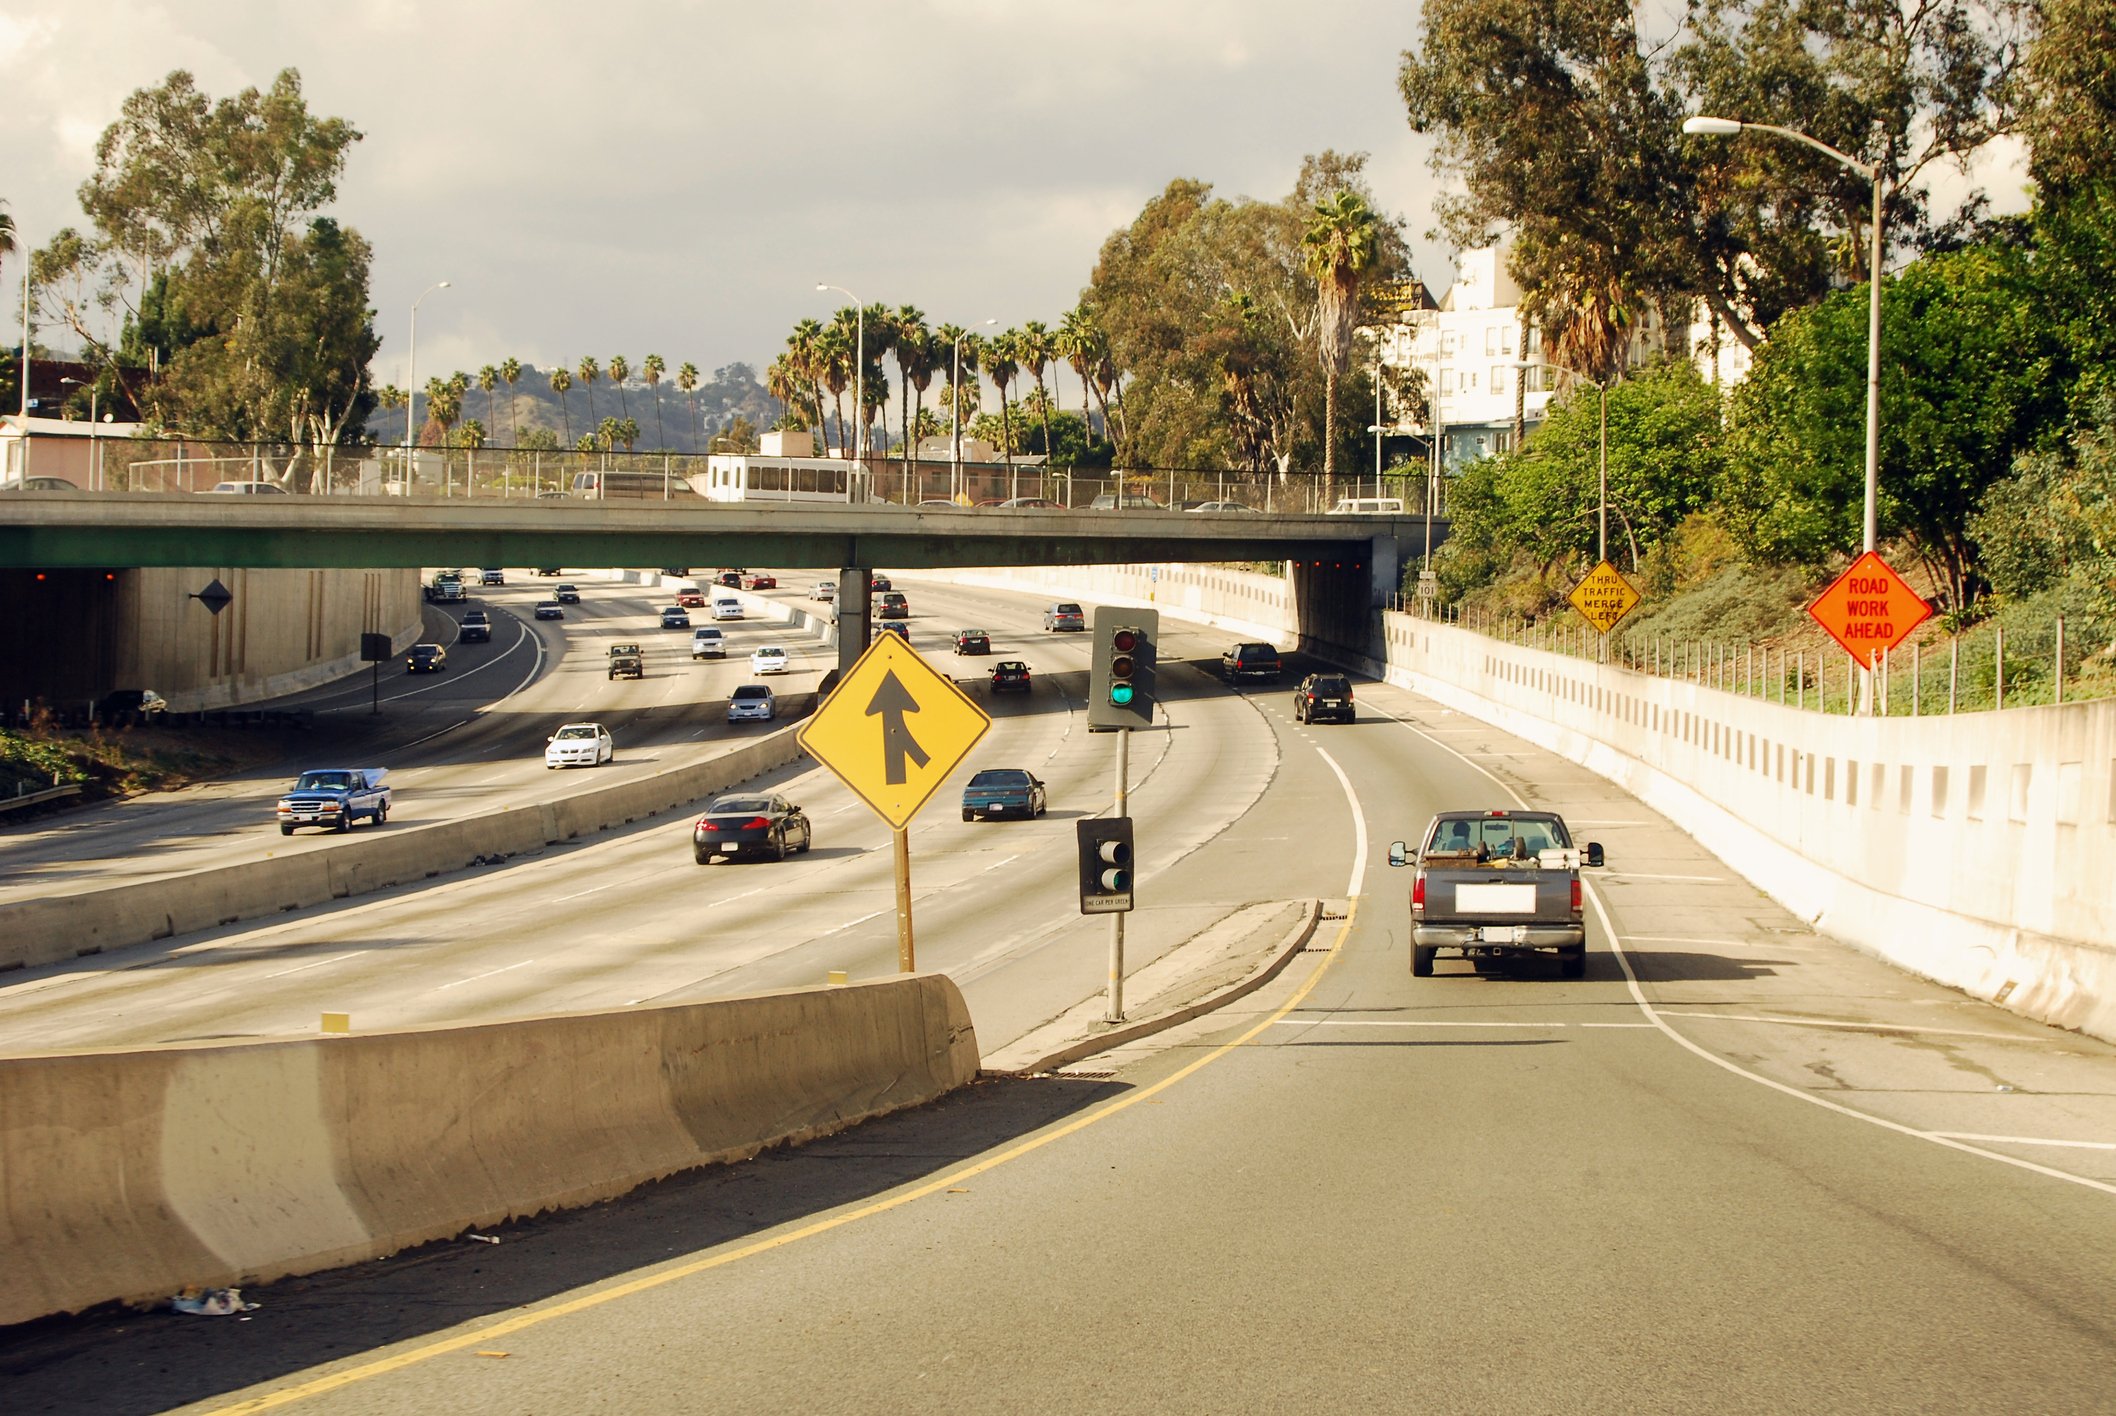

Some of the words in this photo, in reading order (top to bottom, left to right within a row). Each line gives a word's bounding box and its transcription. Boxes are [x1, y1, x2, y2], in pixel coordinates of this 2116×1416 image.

[1591, 575, 1618, 584] THRU
[1420, 586, 1434, 595] 101
[1849, 578, 1889, 594] ROAD
[1583, 587, 1625, 596] TRAFFIC
[1584, 599, 1624, 609] MERGE
[1847, 600, 1889, 617] WORK
[1591, 611, 1618, 620] LEFT
[1844, 623, 1894, 639] AHEAD
